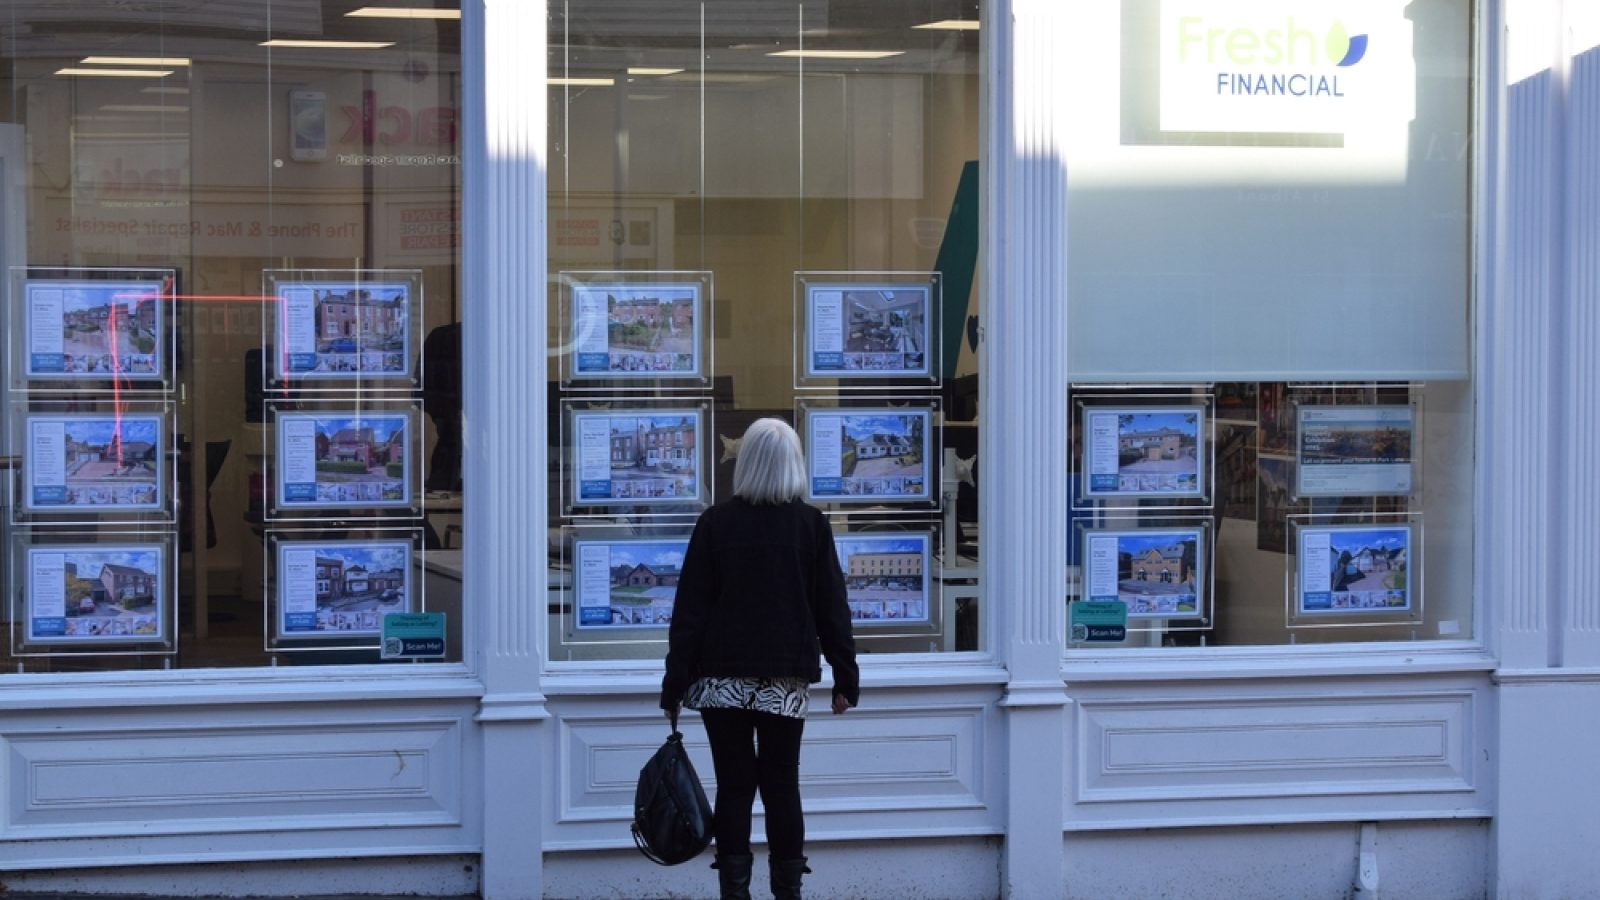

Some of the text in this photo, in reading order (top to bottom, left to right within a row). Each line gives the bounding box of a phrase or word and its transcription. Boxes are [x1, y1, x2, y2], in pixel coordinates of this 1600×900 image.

[1179, 15, 1316, 66] Fresh
[1217, 72, 1345, 96] FINANCIAL
[1090, 629, 1123, 637] Scan Me!
[405, 642, 441, 651] Scan Me!
